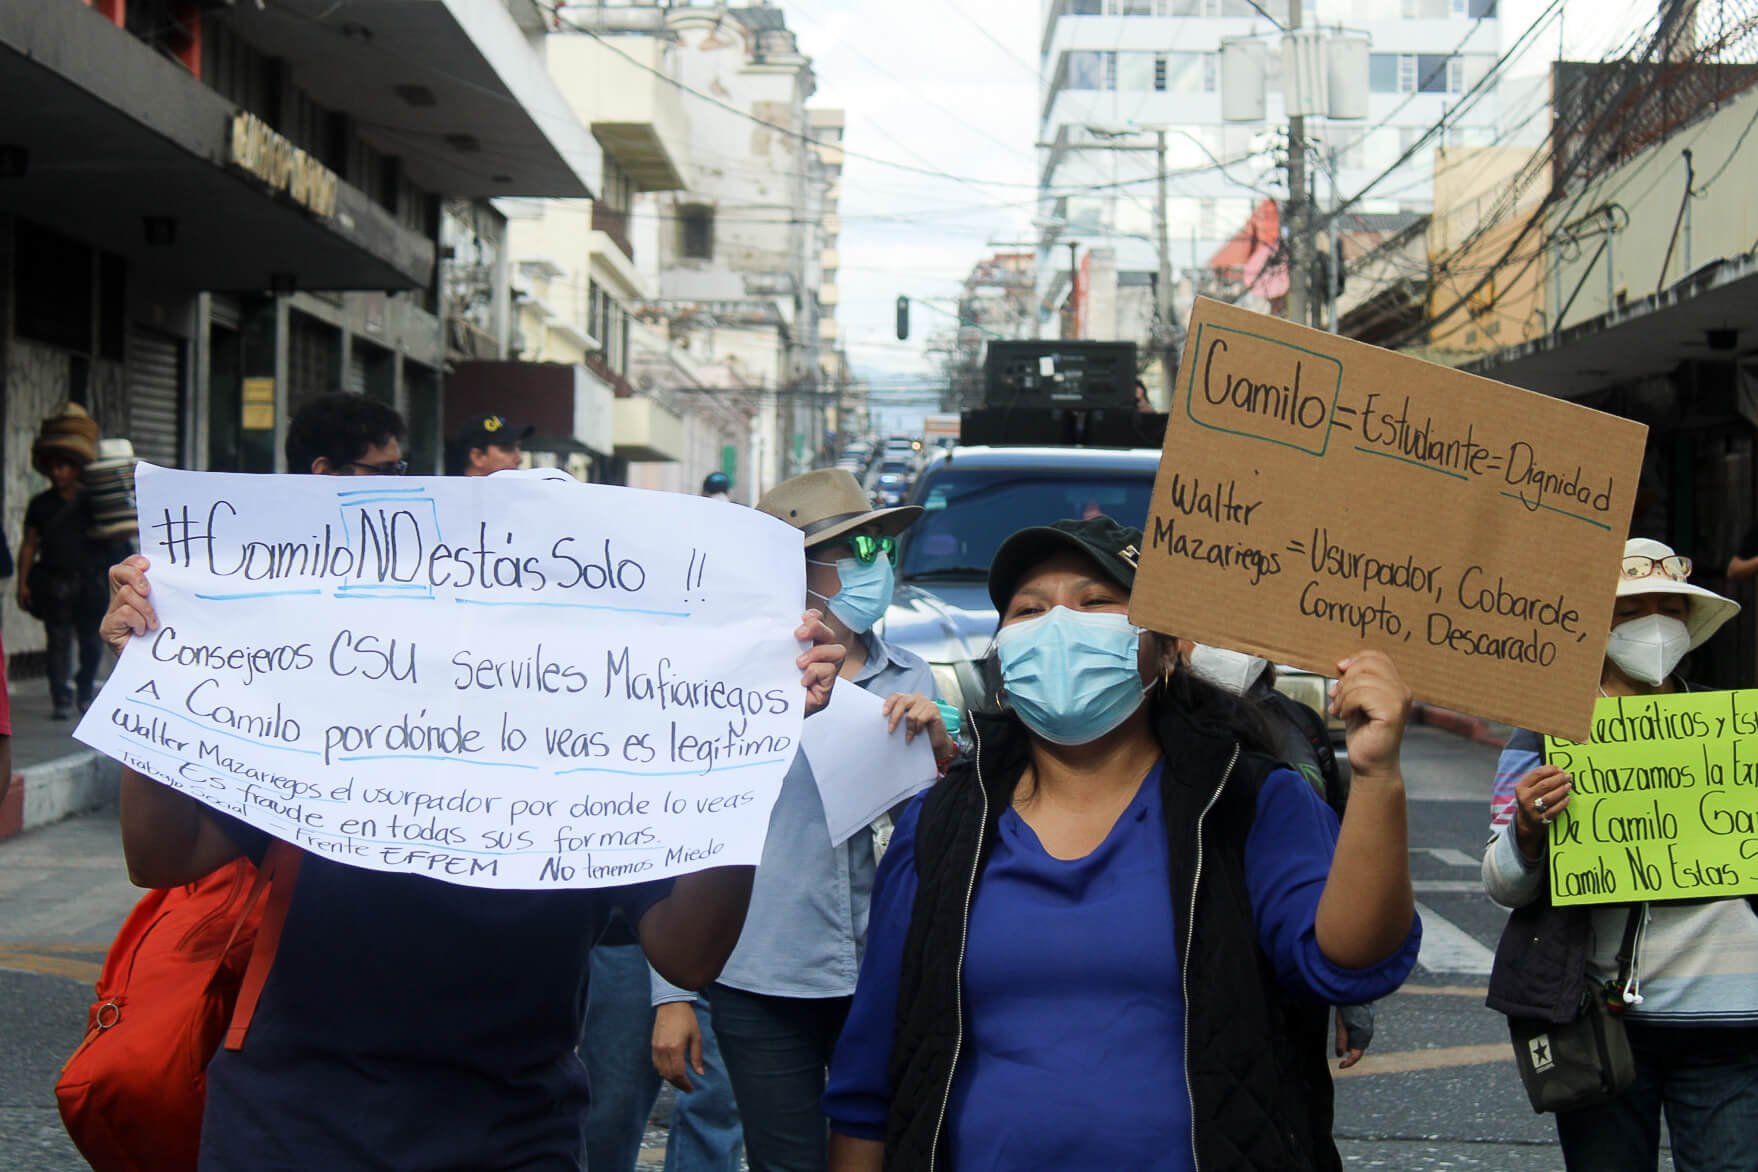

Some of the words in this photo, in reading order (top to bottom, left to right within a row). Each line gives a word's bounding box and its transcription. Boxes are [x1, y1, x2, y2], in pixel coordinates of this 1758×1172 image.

[1171, 473, 1263, 525] Walter
[1153, 516, 1282, 585] Mazariegos
[1458, 565, 1587, 643] Cobarde,
[1300, 580, 1412, 642] Corrupto,
[1427, 612, 1556, 667] Descarado
[135, 679, 161, 700] A
[186, 678, 301, 743] Camilo
[501, 712, 527, 751] lo
[545, 726, 610, 758] veas
[623, 730, 655, 762] es
[152, 627, 313, 685] Consejeros
[330, 629, 417, 683] CSU
[453, 644, 588, 693] Serviles
[605, 646, 790, 737] Mafiariegos
[111, 708, 189, 750] Walter
[199, 740, 322, 800] Mazariegos
[330, 777, 354, 801] el
[363, 787, 503, 818] usurpador
[510, 797, 554, 826] por
[569, 792, 649, 817] donde
[664, 791, 686, 814] lo
[697, 790, 757, 814] veas
[179, 761, 226, 790] Es
[236, 783, 324, 828] fraude
[340, 818, 377, 838] en
[386, 814, 467, 844] todas
[481, 828, 535, 852] sus
[1702, 743, 1724, 787] la
[296, 827, 369, 856] Frente
[380, 847, 498, 876] EFPEM
[539, 857, 575, 882] No
[588, 853, 654, 880] tenemos
[665, 839, 725, 867] Miedo
[1552, 808, 1583, 846] De
[1592, 798, 1679, 844] Camilo
[1699, 790, 1758, 835] Ga
[1552, 852, 1617, 897] Camilo
[1625, 846, 1662, 891] No
